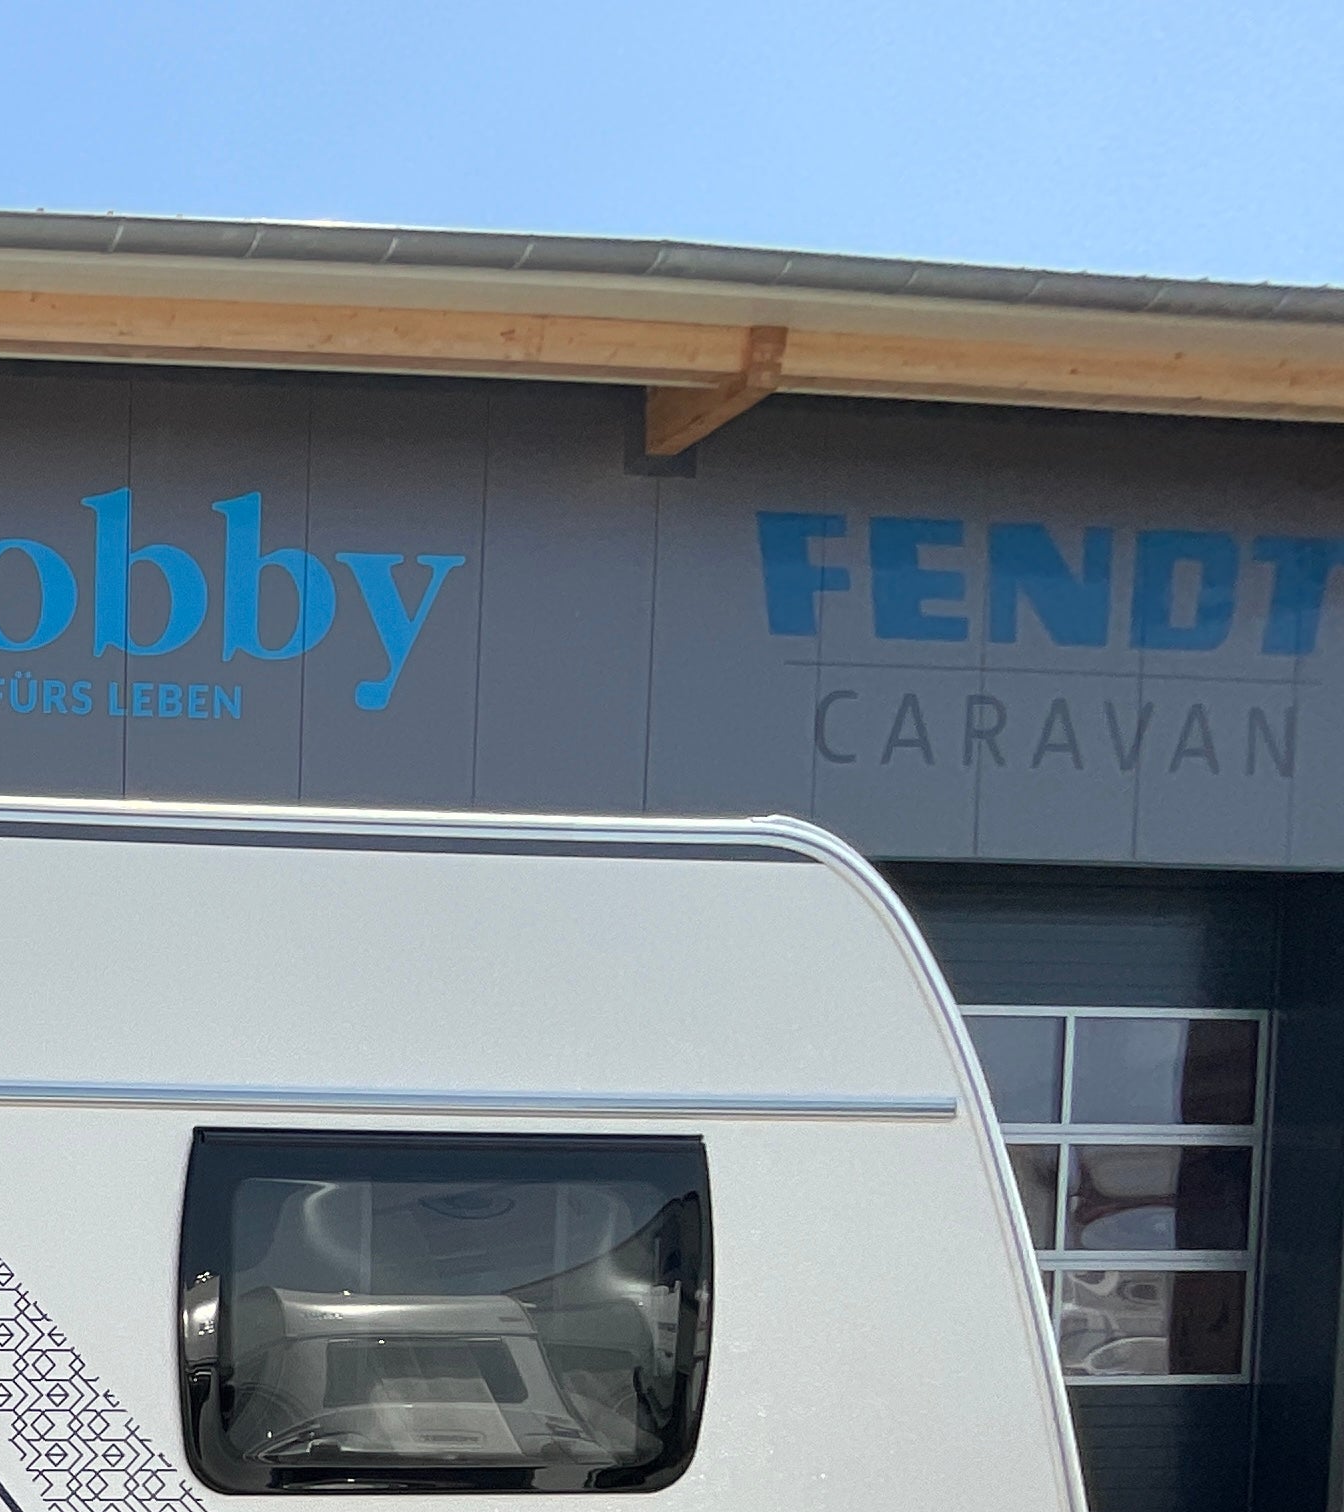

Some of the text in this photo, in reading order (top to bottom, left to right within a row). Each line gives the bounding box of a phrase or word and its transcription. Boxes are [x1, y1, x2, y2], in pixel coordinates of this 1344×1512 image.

[755, 511, 1344, 656] FENDT
[108, 682, 243, 720] LEBEN
[814, 689, 1298, 778] CARAVAN
